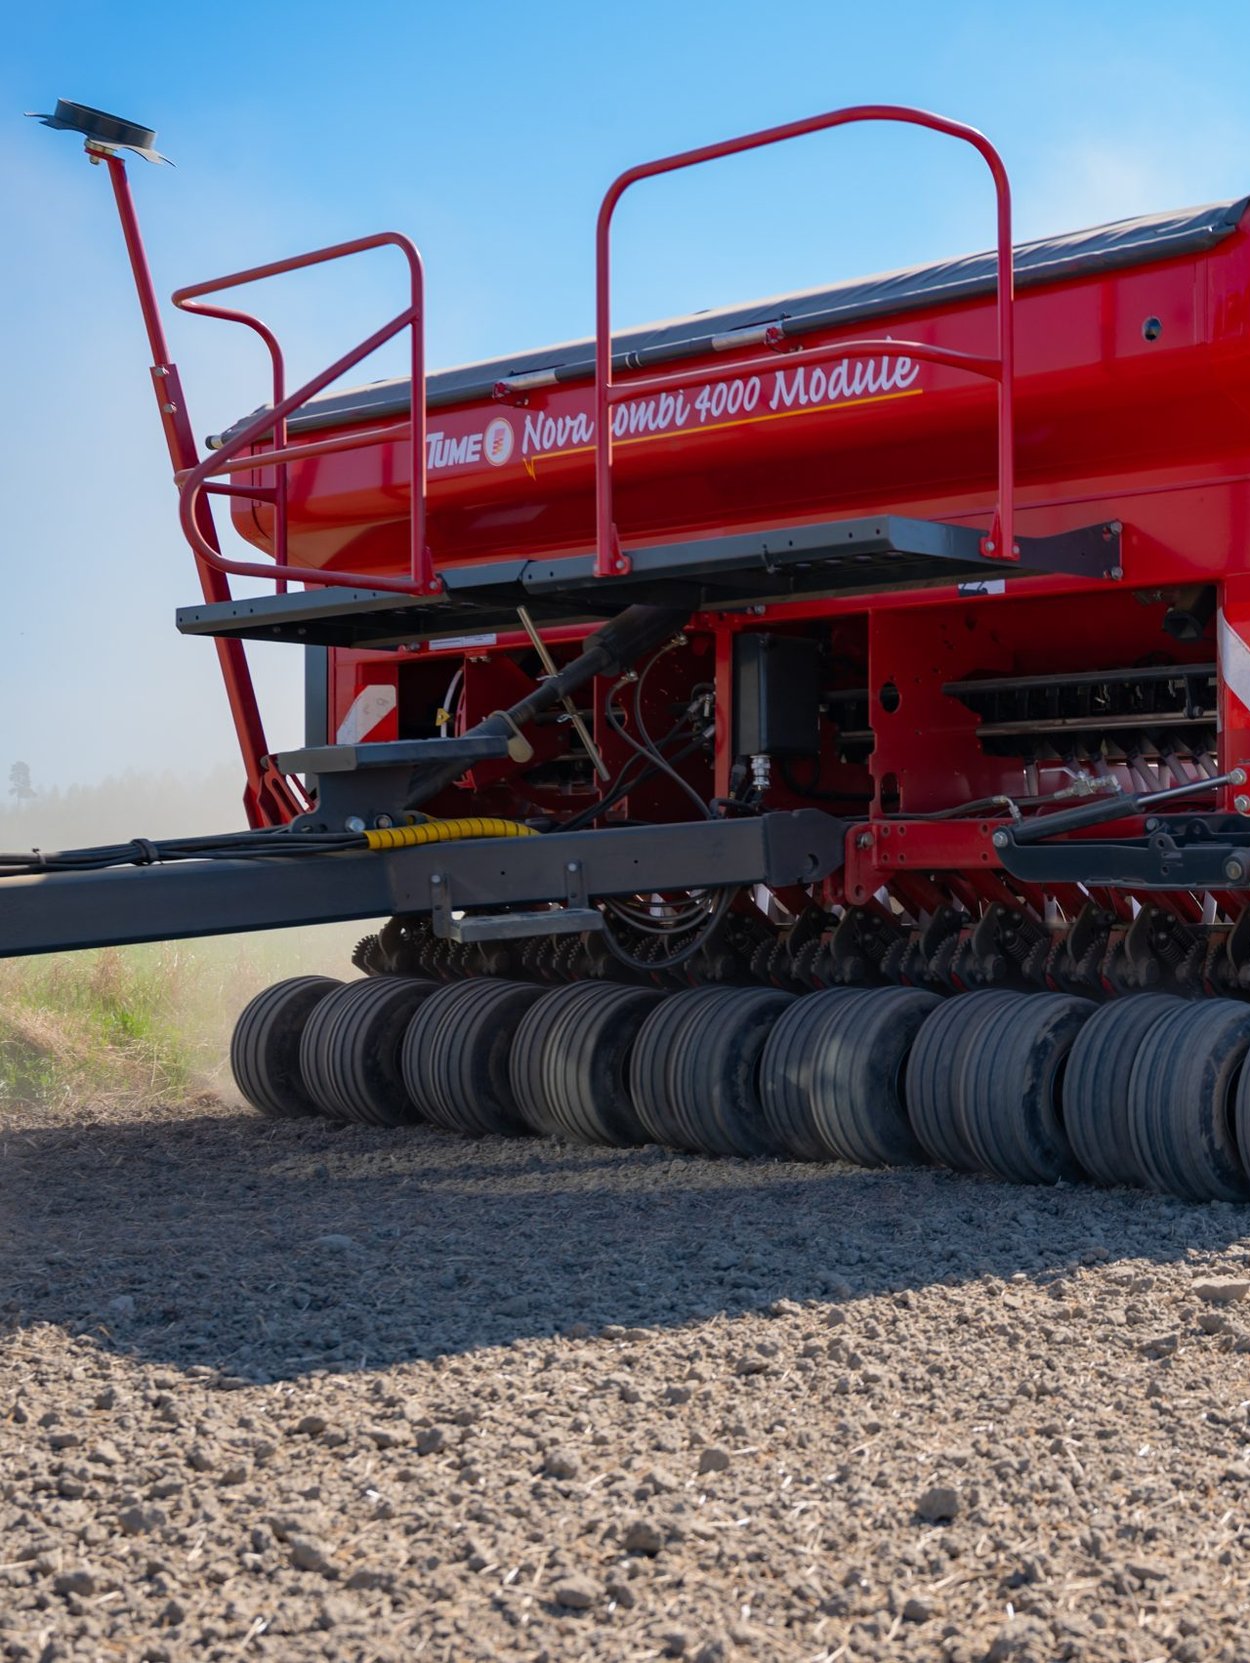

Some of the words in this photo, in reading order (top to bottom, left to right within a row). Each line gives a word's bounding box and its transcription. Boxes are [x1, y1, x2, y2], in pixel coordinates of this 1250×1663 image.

[522, 411, 594, 454] Nova
[611, 389, 690, 437] ombi
[695, 376, 761, 422] 4000
[769, 335, 920, 410] Module
